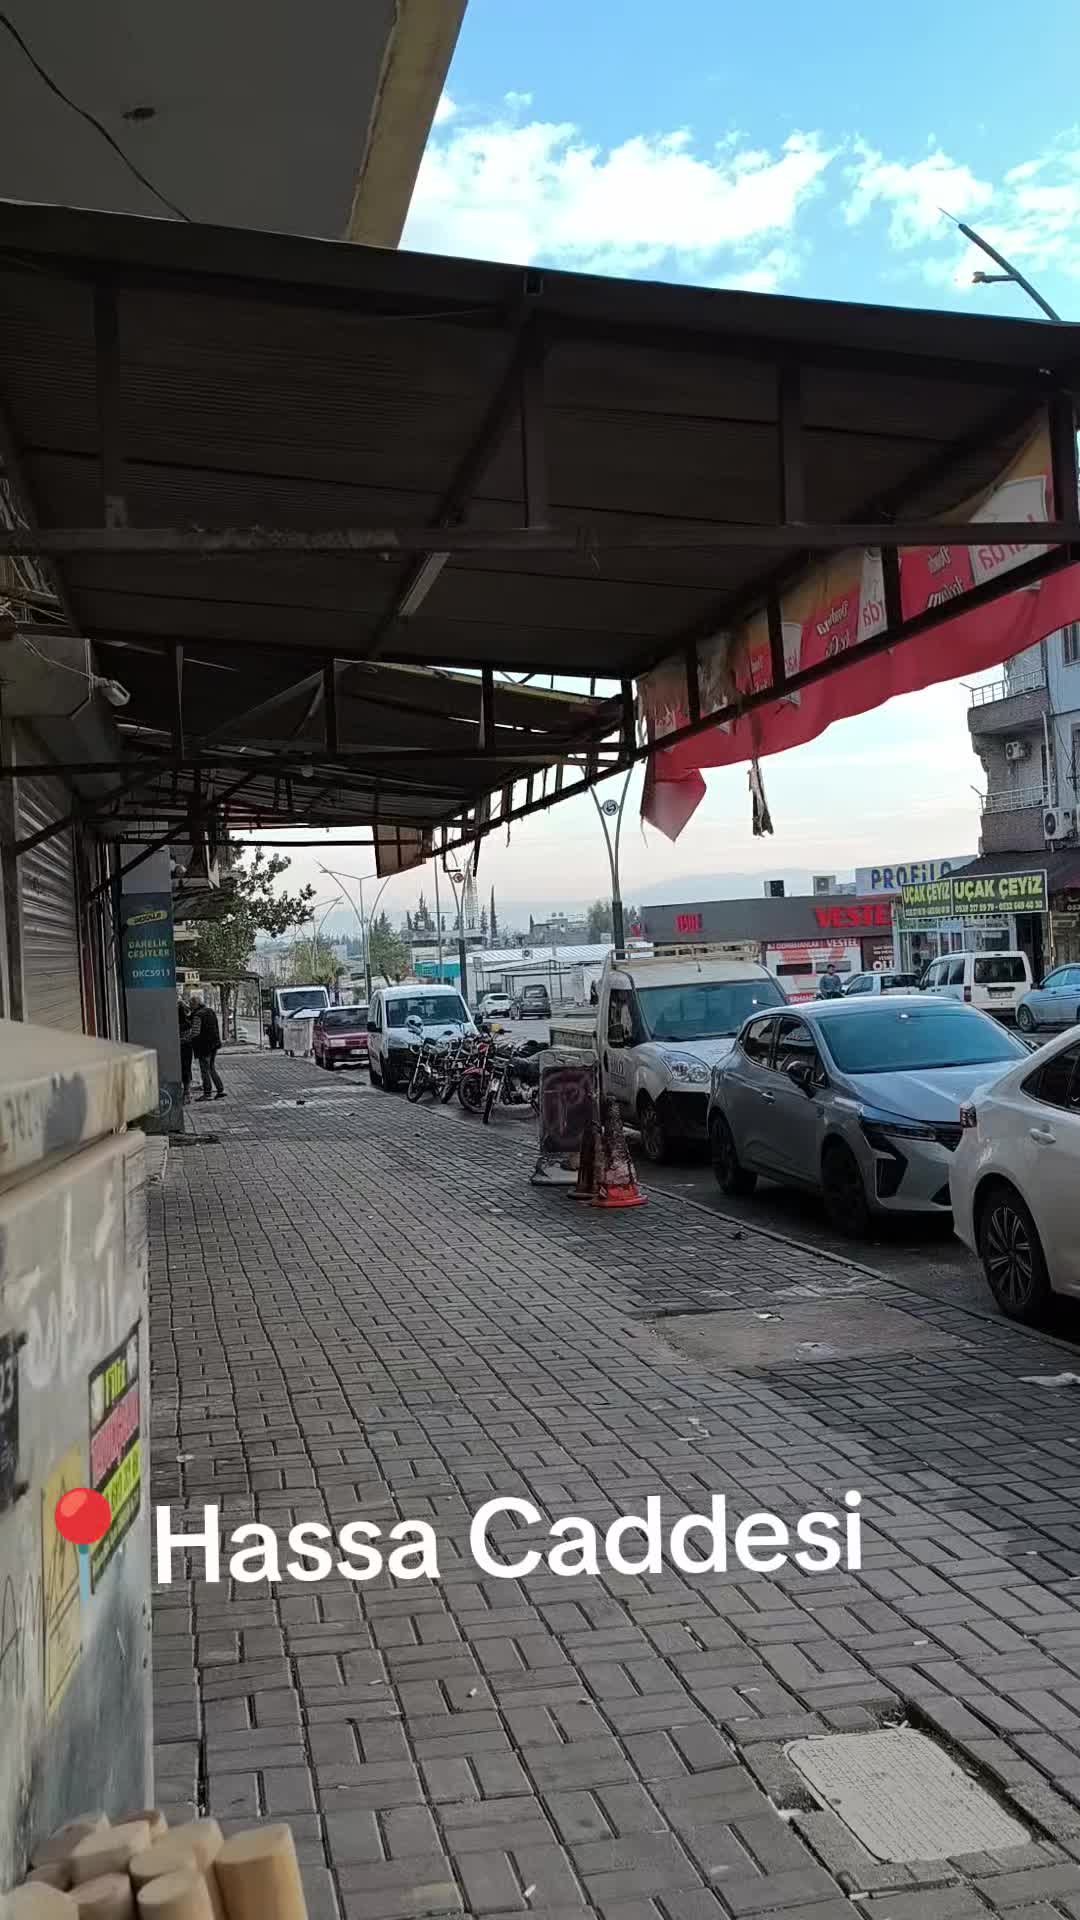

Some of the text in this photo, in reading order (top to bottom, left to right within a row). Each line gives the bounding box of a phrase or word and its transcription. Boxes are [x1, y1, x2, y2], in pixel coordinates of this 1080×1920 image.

[954, 880, 995, 902] UÇAK
[816, 903, 893, 929] VESTE
[826, 938, 858, 948] VESTEL
